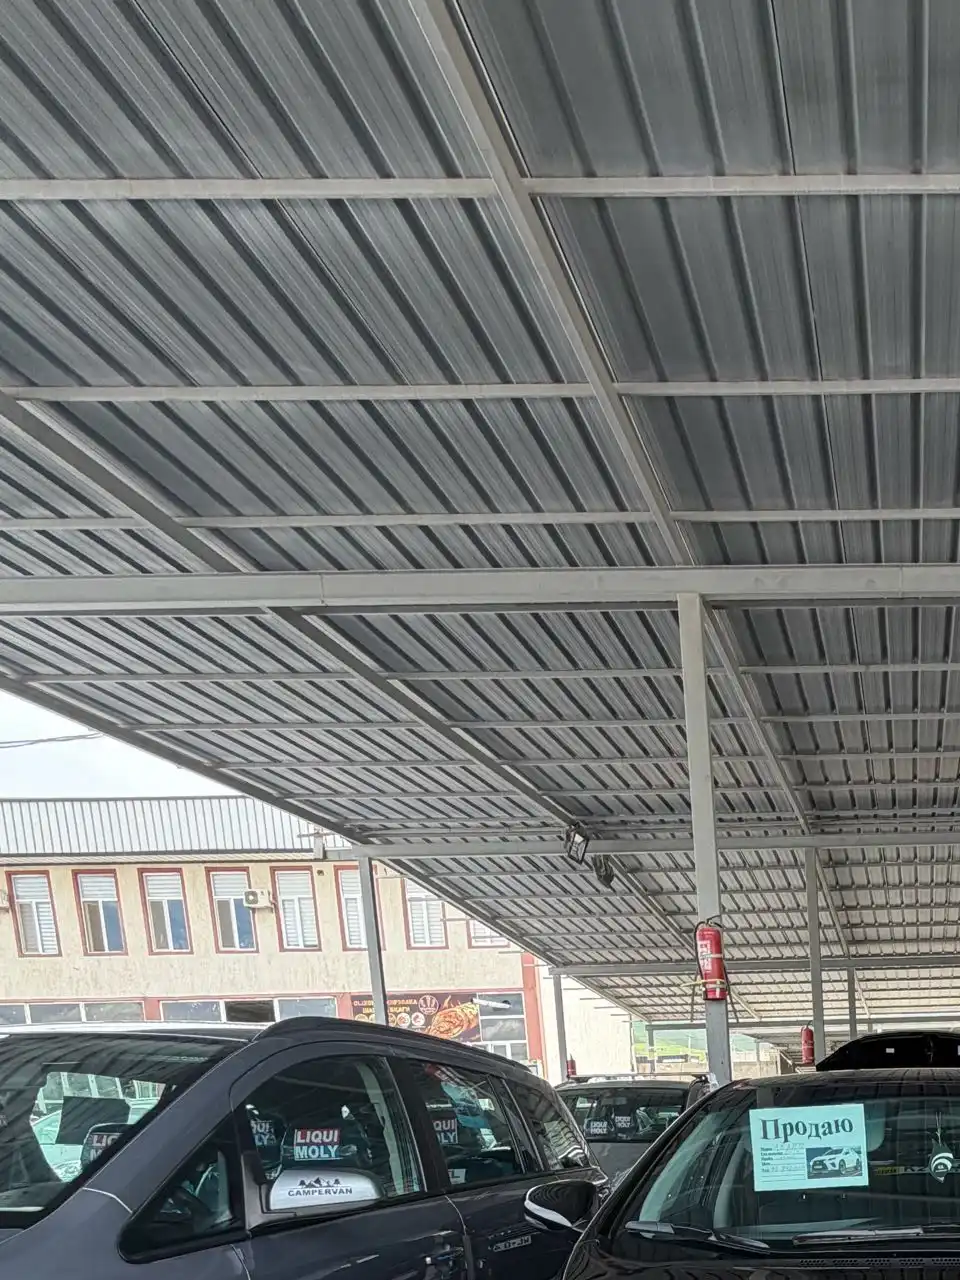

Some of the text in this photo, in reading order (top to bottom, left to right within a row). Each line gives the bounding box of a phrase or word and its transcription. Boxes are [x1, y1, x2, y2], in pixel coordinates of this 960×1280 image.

[296, 1129, 339, 1143] LIQUI
[760, 1117, 854, 1143] Продаю
[295, 1145, 339, 1159] MOLY
[288, 1187, 353, 1197] CAMPERVAN
